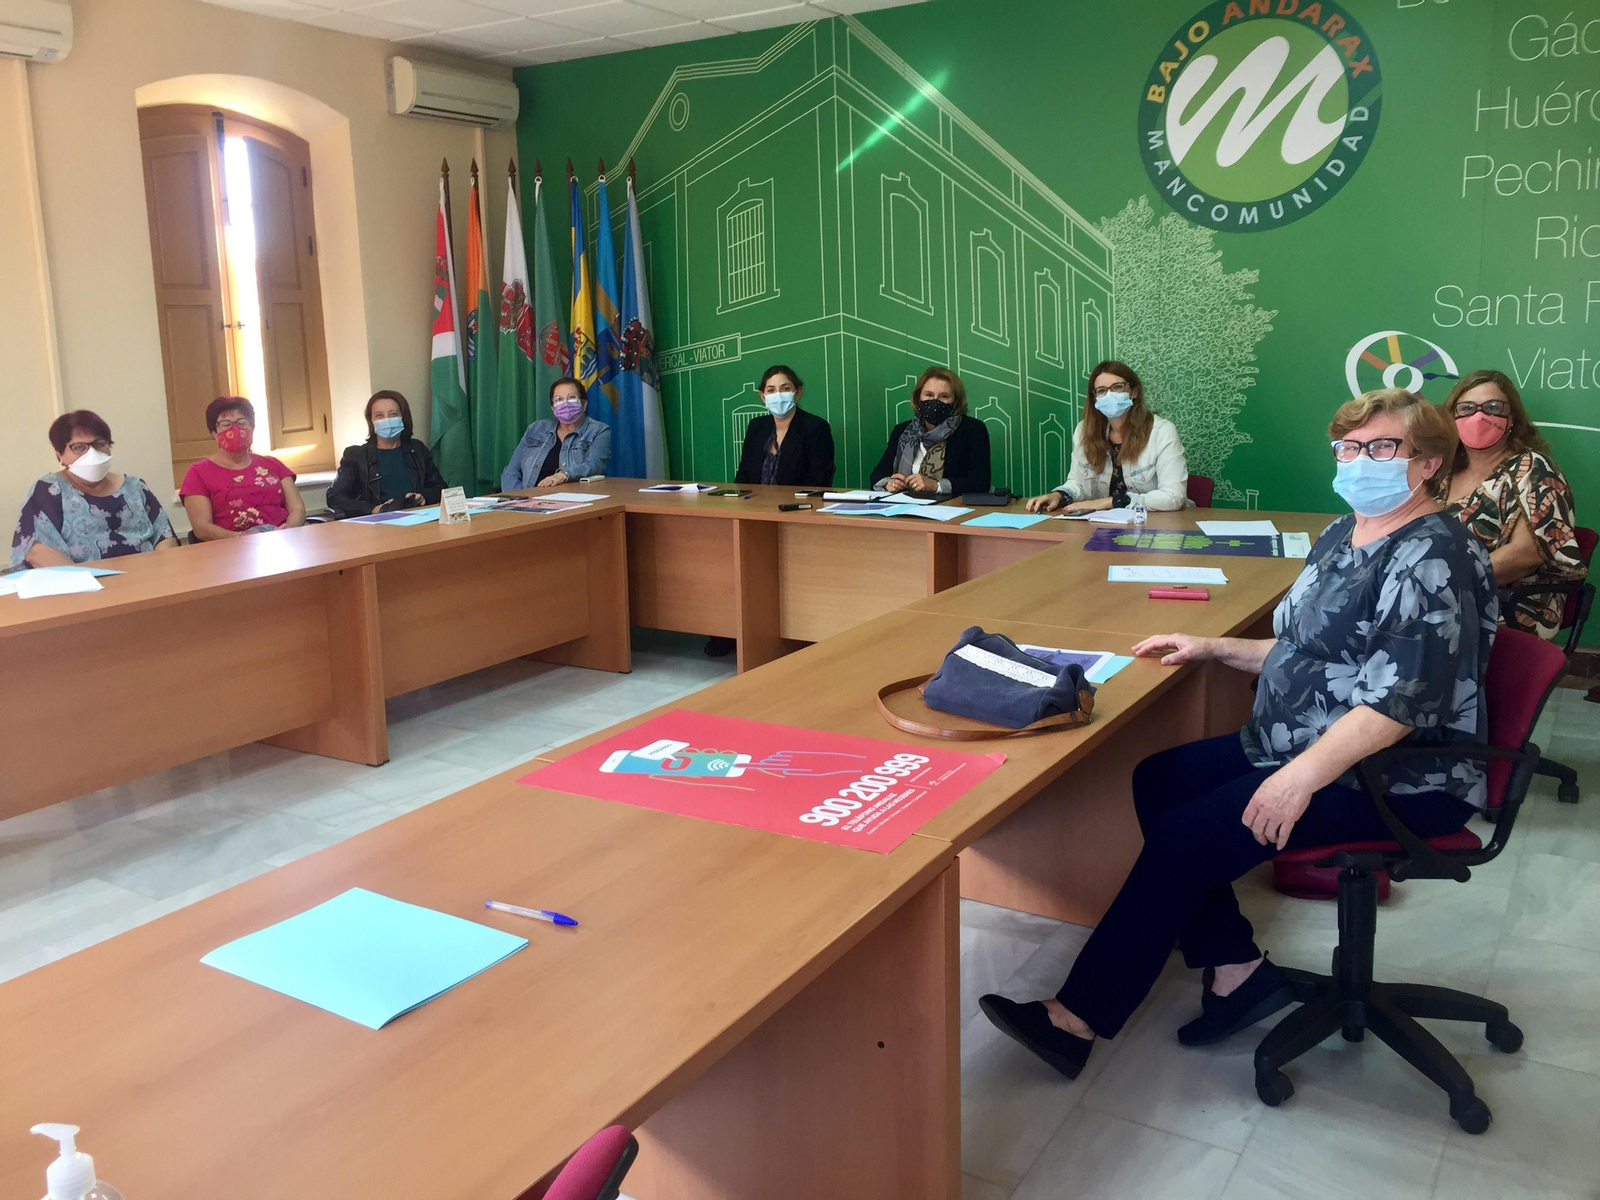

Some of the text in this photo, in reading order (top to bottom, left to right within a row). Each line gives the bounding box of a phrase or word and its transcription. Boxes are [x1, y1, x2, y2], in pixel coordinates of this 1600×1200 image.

[1147, 0, 1374, 103] BAJO ANDARAX
[1148, 106, 1369, 225] MANCOMUNIDAD
[1462, 146, 1600, 198] Pechi
[1433, 284, 1566, 327] Santa
[799, 797, 863, 826] 900
[838, 775, 898, 802] 200
[873, 753, 930, 777] 999
